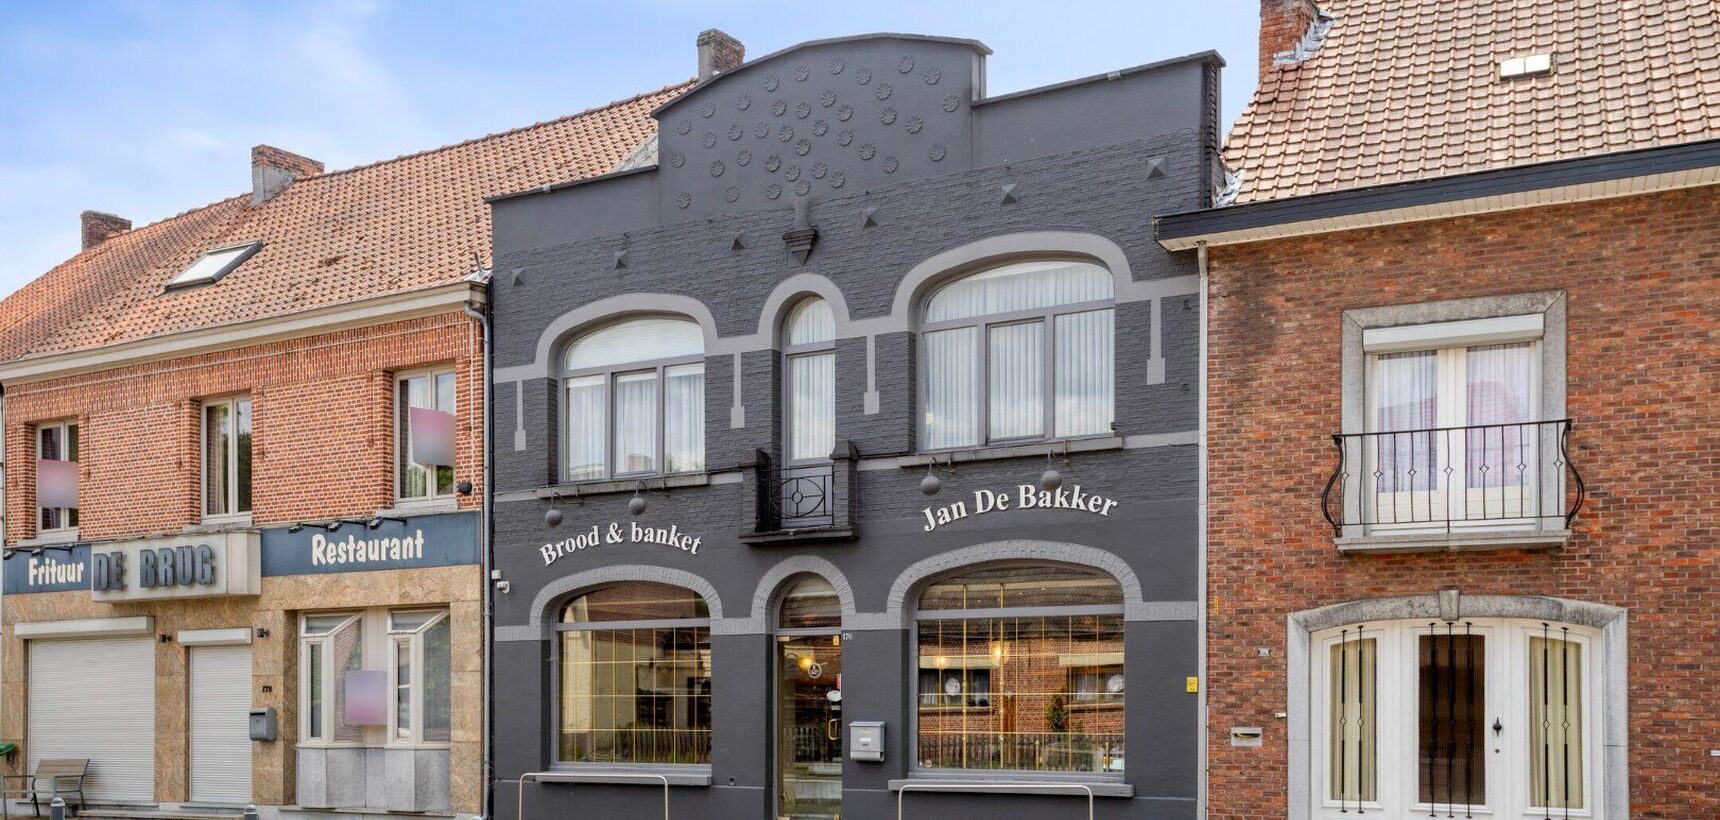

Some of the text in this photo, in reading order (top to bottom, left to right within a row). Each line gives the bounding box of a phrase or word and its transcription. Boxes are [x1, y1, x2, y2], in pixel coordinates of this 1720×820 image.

[921, 484, 1117, 532] Jan De Bakker
[311, 529, 425, 566] Restaurant
[539, 522, 702, 566] Brood & banket
[29, 558, 85, 586] Frituur
[93, 544, 215, 592] DE BRUG
